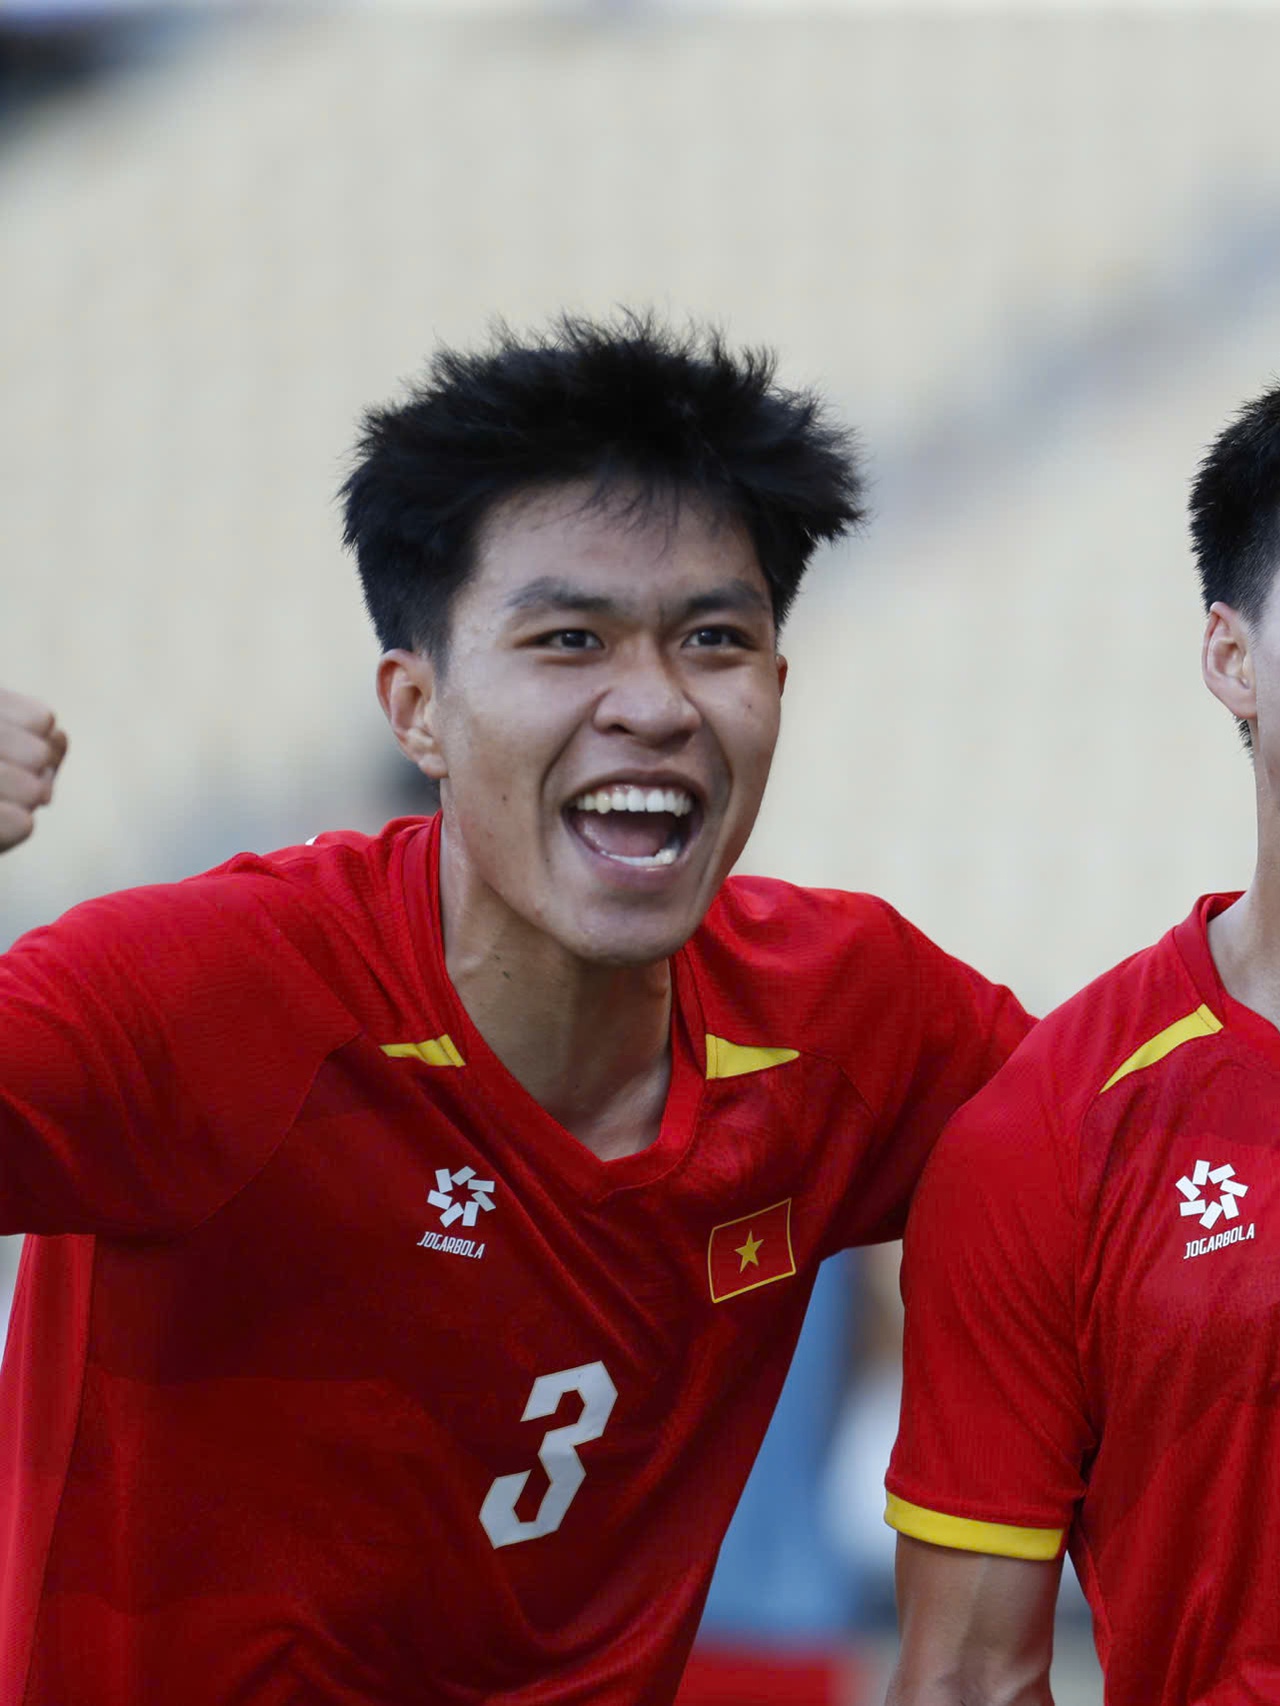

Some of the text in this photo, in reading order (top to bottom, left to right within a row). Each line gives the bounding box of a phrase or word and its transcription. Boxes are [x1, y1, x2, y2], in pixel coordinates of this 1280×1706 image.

[416, 1231, 485, 1259] JOGARBOLA
[1183, 1222, 1255, 1260] JOGARBOLA
[479, 1360, 618, 1548] 3
